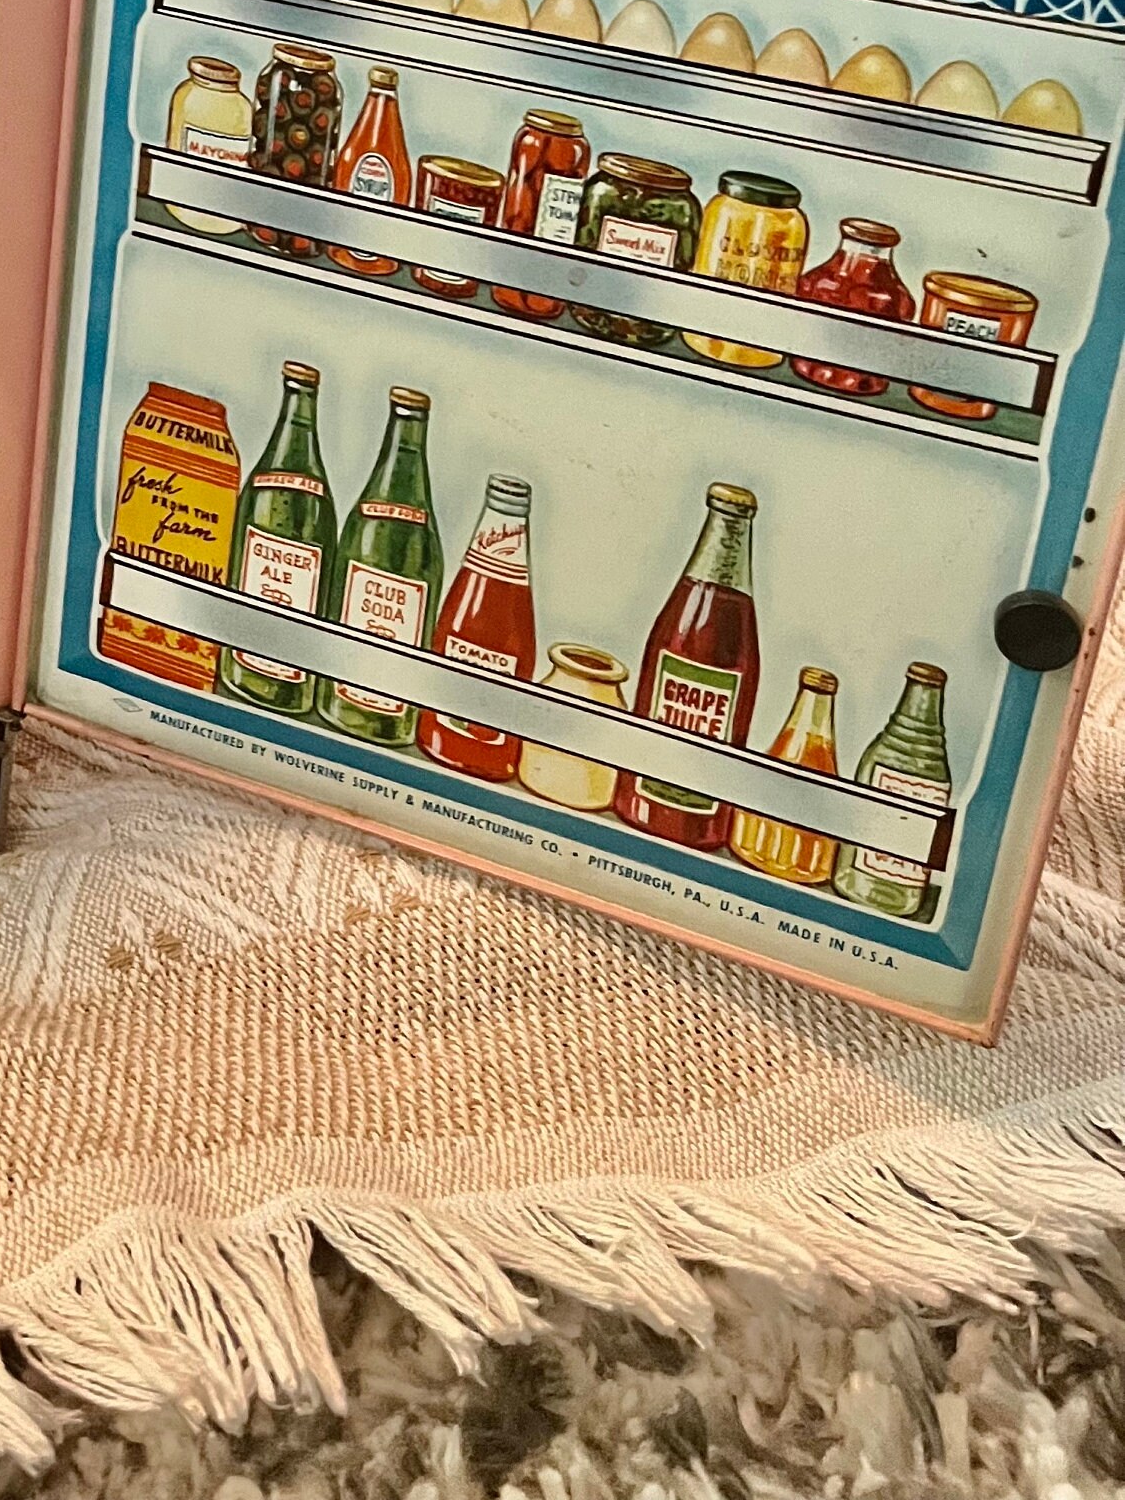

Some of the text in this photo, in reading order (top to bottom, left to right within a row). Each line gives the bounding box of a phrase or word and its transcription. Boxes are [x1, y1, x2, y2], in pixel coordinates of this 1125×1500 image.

[644, 238, 667, 255] Mix
[946, 317, 998, 341] PEACH
[133, 411, 235, 455] BUTTERMILK
[121, 466, 183, 504] fresh
[151, 495, 219, 524] FROM THE
[152, 512, 217, 543] farm
[116, 535, 224, 584] BUTTERMILK
[253, 543, 312, 571] GINGER
[260, 565, 293, 584] ALE
[364, 580, 406, 605] CLUB
[361, 598, 405, 624] SODA
[450, 639, 509, 667] TOMATO
[664, 678, 729, 716] GRAPE
[658, 704, 723, 739] JUICE
[150, 710, 244, 749] MANUFACTURED
[251, 743, 267, 756] BY
[274, 750, 345, 783] WOLVERINE
[352, 776, 399, 800] SUPPLY
[405, 794, 414, 806] &
[421, 800, 534, 845] MANUFACTURING
[541, 839, 562, 856] CO.
[588, 854, 675, 895] PITTSBURGH,
[720, 900, 765, 924] U.S.A.
[778, 920, 821, 943] MADE
[829, 937, 845, 952] IN
[851, 945, 899, 970] U.S.A.
